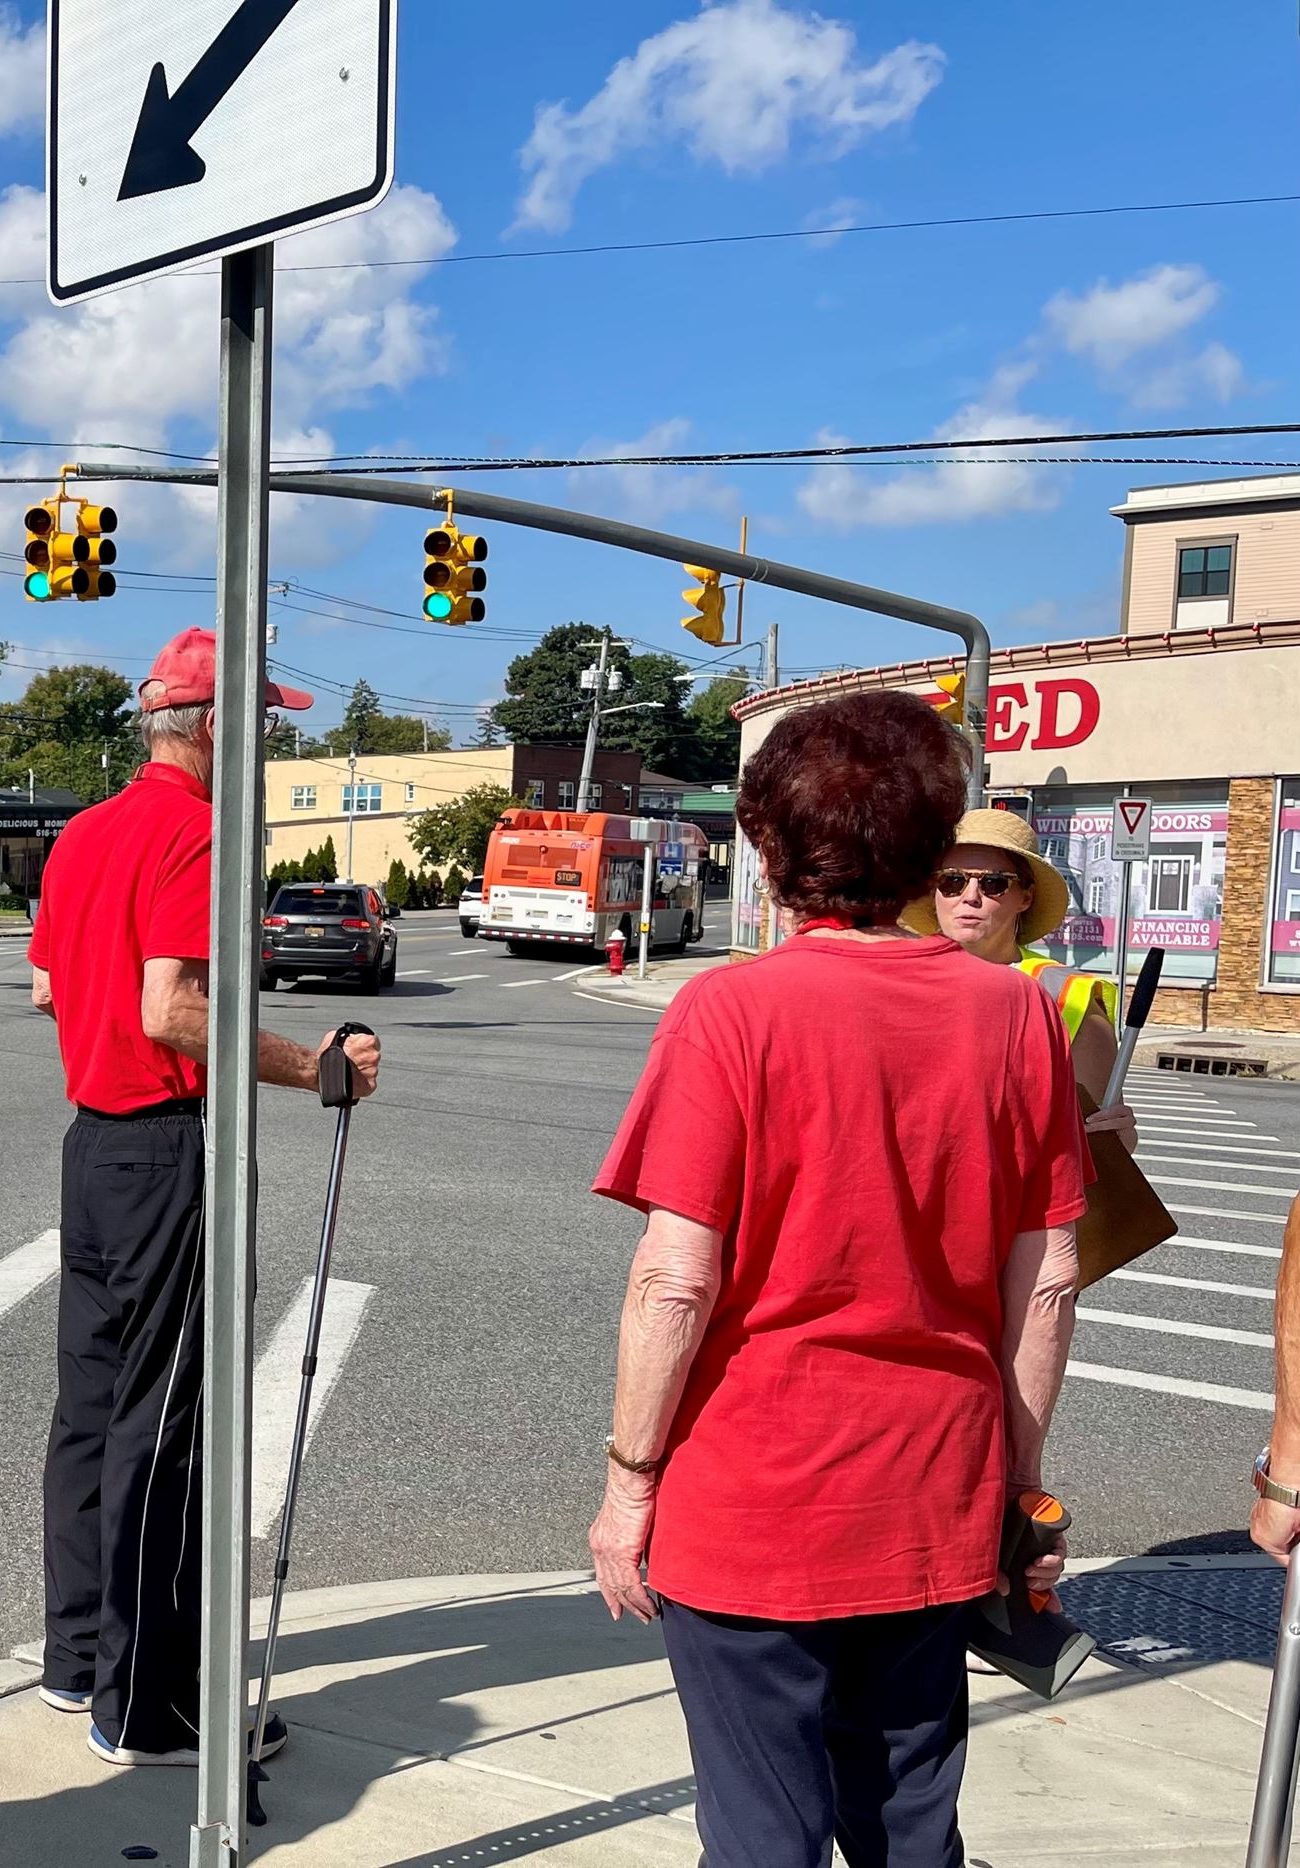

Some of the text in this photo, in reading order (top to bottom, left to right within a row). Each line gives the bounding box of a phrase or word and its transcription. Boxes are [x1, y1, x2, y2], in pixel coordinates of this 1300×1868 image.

[985, 678, 1101, 753] ED
[44, 819, 67, 828] MOME
[556, 872, 577, 882] STOP
[1132, 921, 1210, 935] FINANCING
[1131, 934, 1210, 946] AVAILABLE
